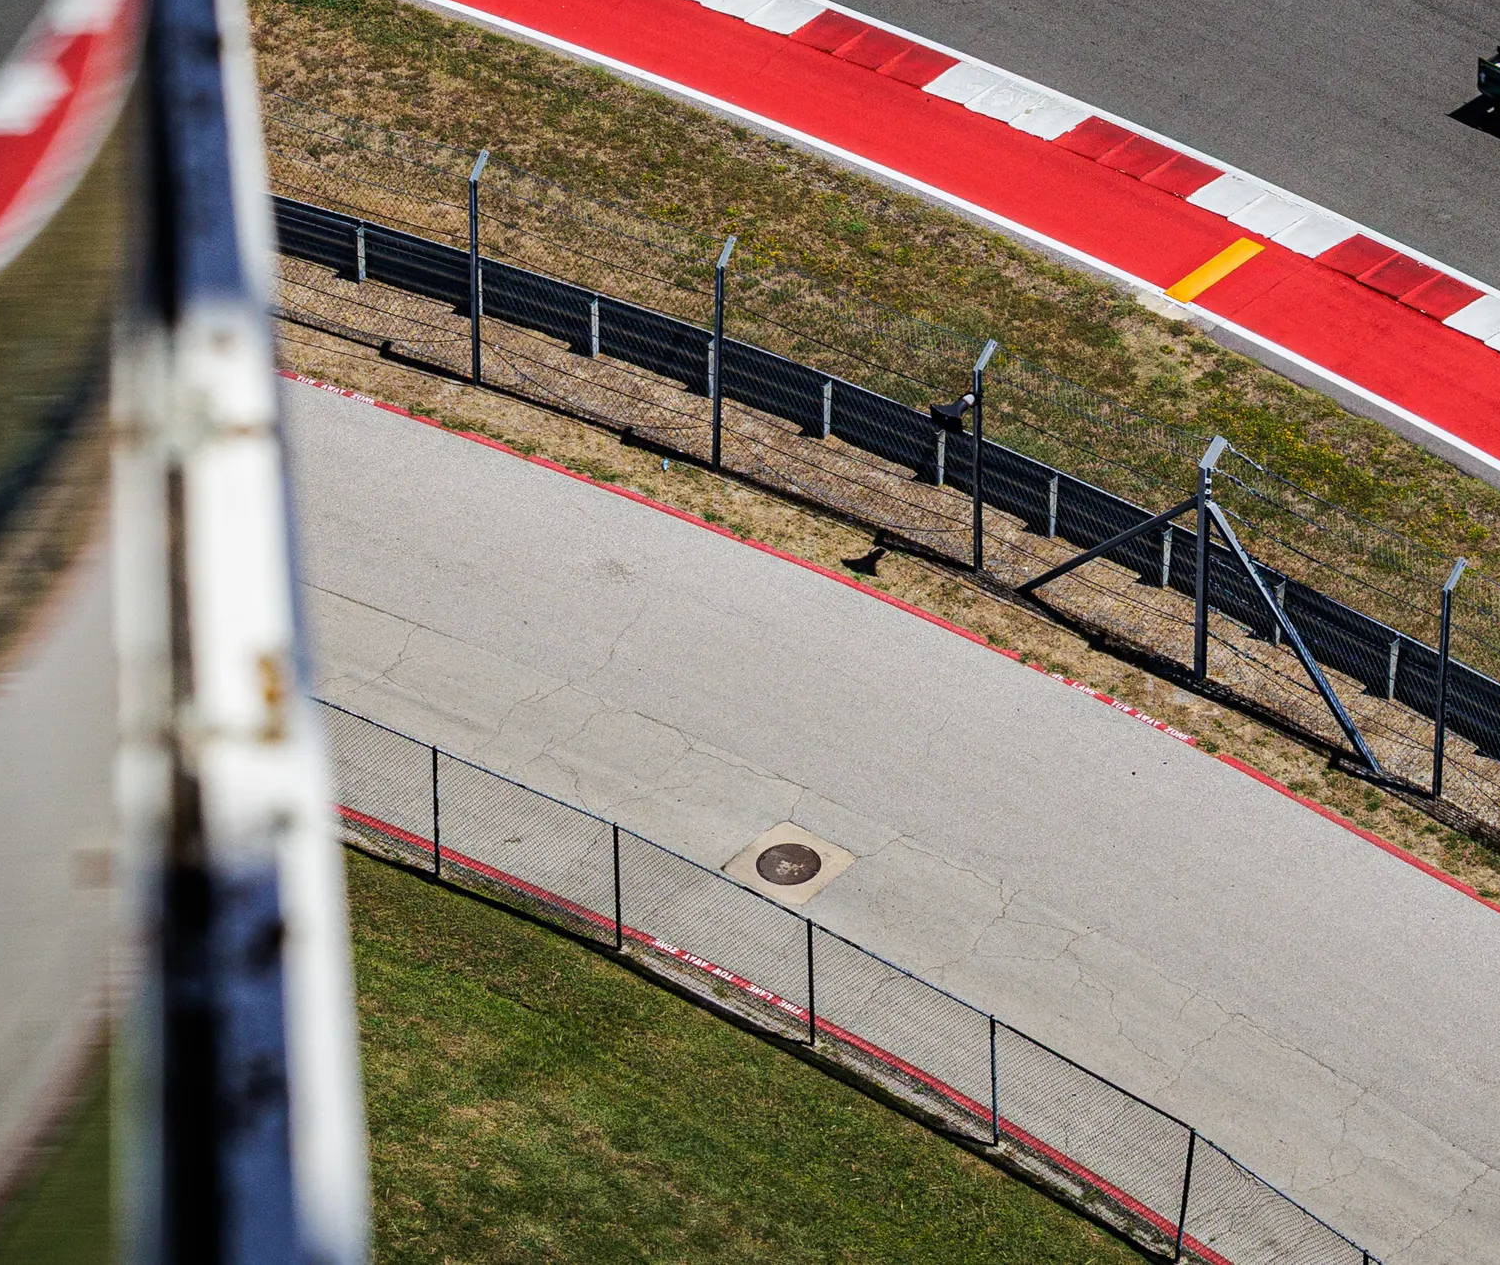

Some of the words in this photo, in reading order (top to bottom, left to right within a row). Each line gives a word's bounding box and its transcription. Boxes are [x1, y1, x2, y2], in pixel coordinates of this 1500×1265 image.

[320, 383, 347, 395] AWAY
[1111, 699, 1133, 713] TOW
[1135, 713, 1162, 727] AWAY
[1164, 727, 1192, 742] ZONE
[651, 938, 680, 954] ZONE
[682, 953, 710, 968] AWAY
[711, 967, 735, 981] TOW
[745, 983, 775, 1001] LANE
[777, 999, 804, 1015] FIRE
